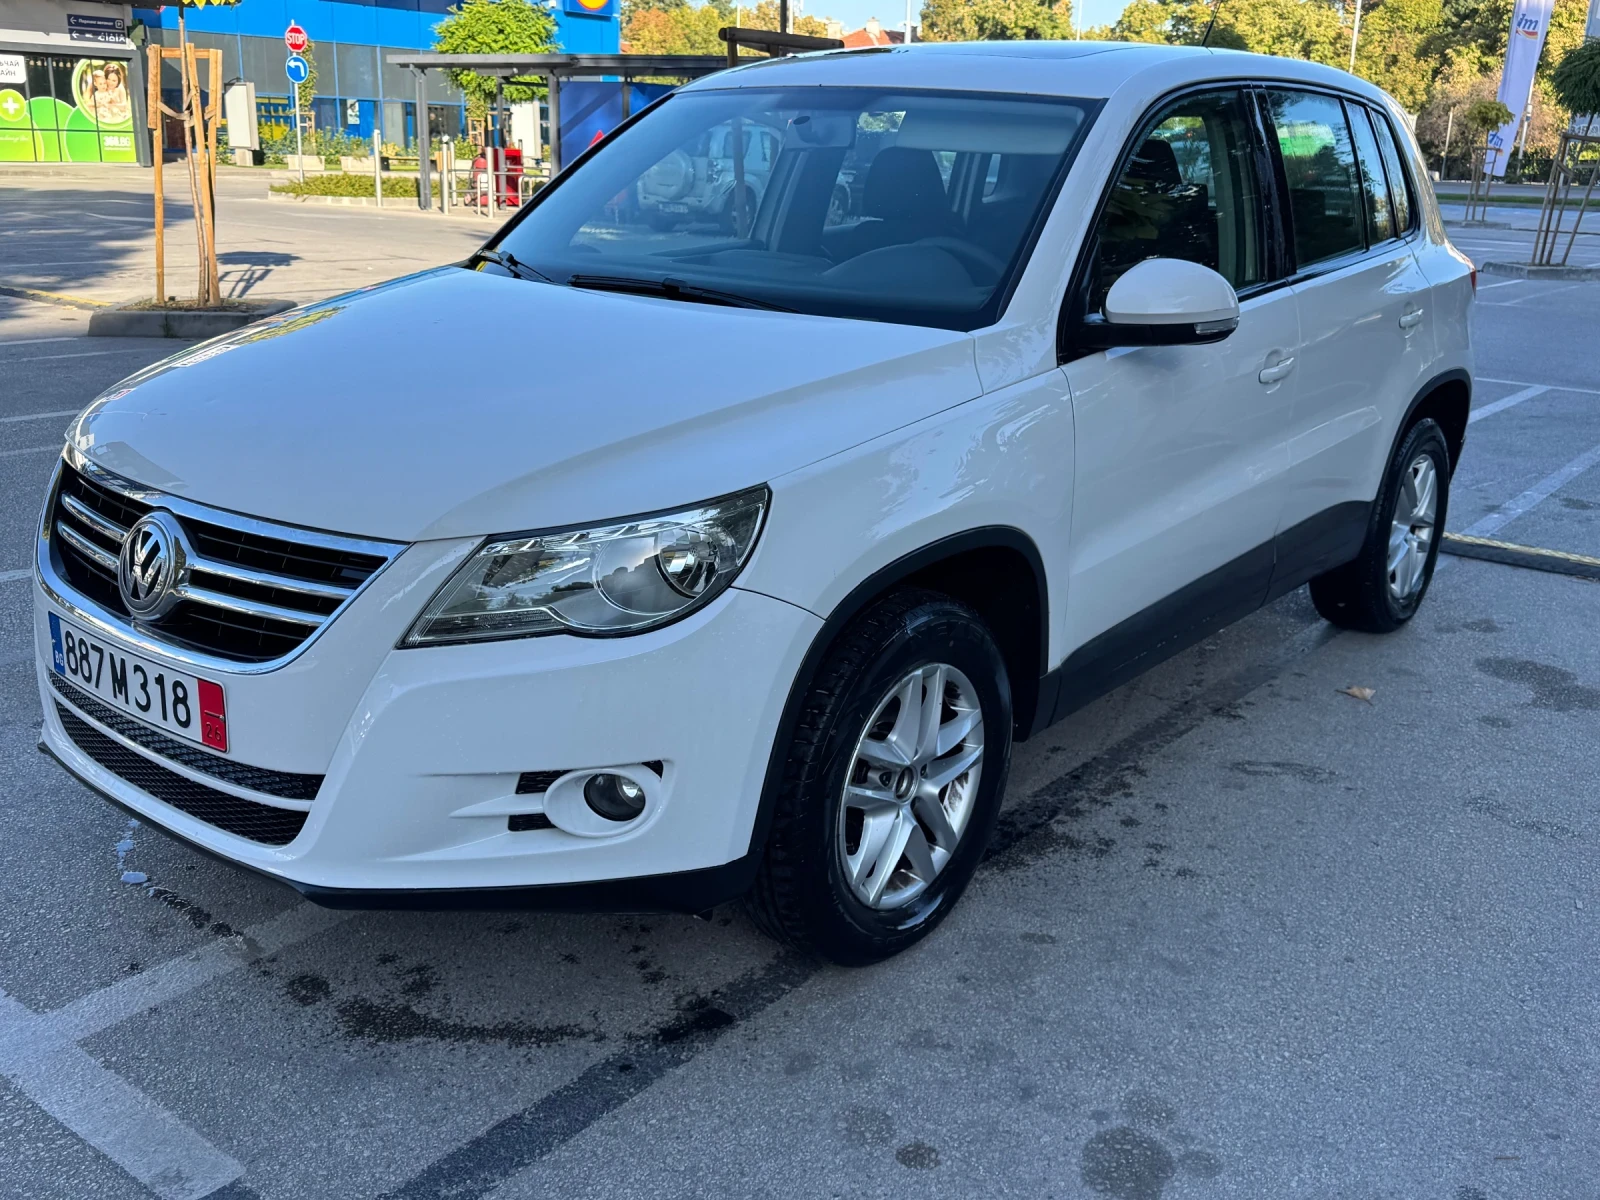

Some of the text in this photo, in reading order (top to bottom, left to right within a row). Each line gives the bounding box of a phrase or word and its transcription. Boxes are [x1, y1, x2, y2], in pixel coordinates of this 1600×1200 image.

[286, 32, 305, 45] STOP
[55, 650, 64, 667] BG
[205, 721, 222, 742] 26
